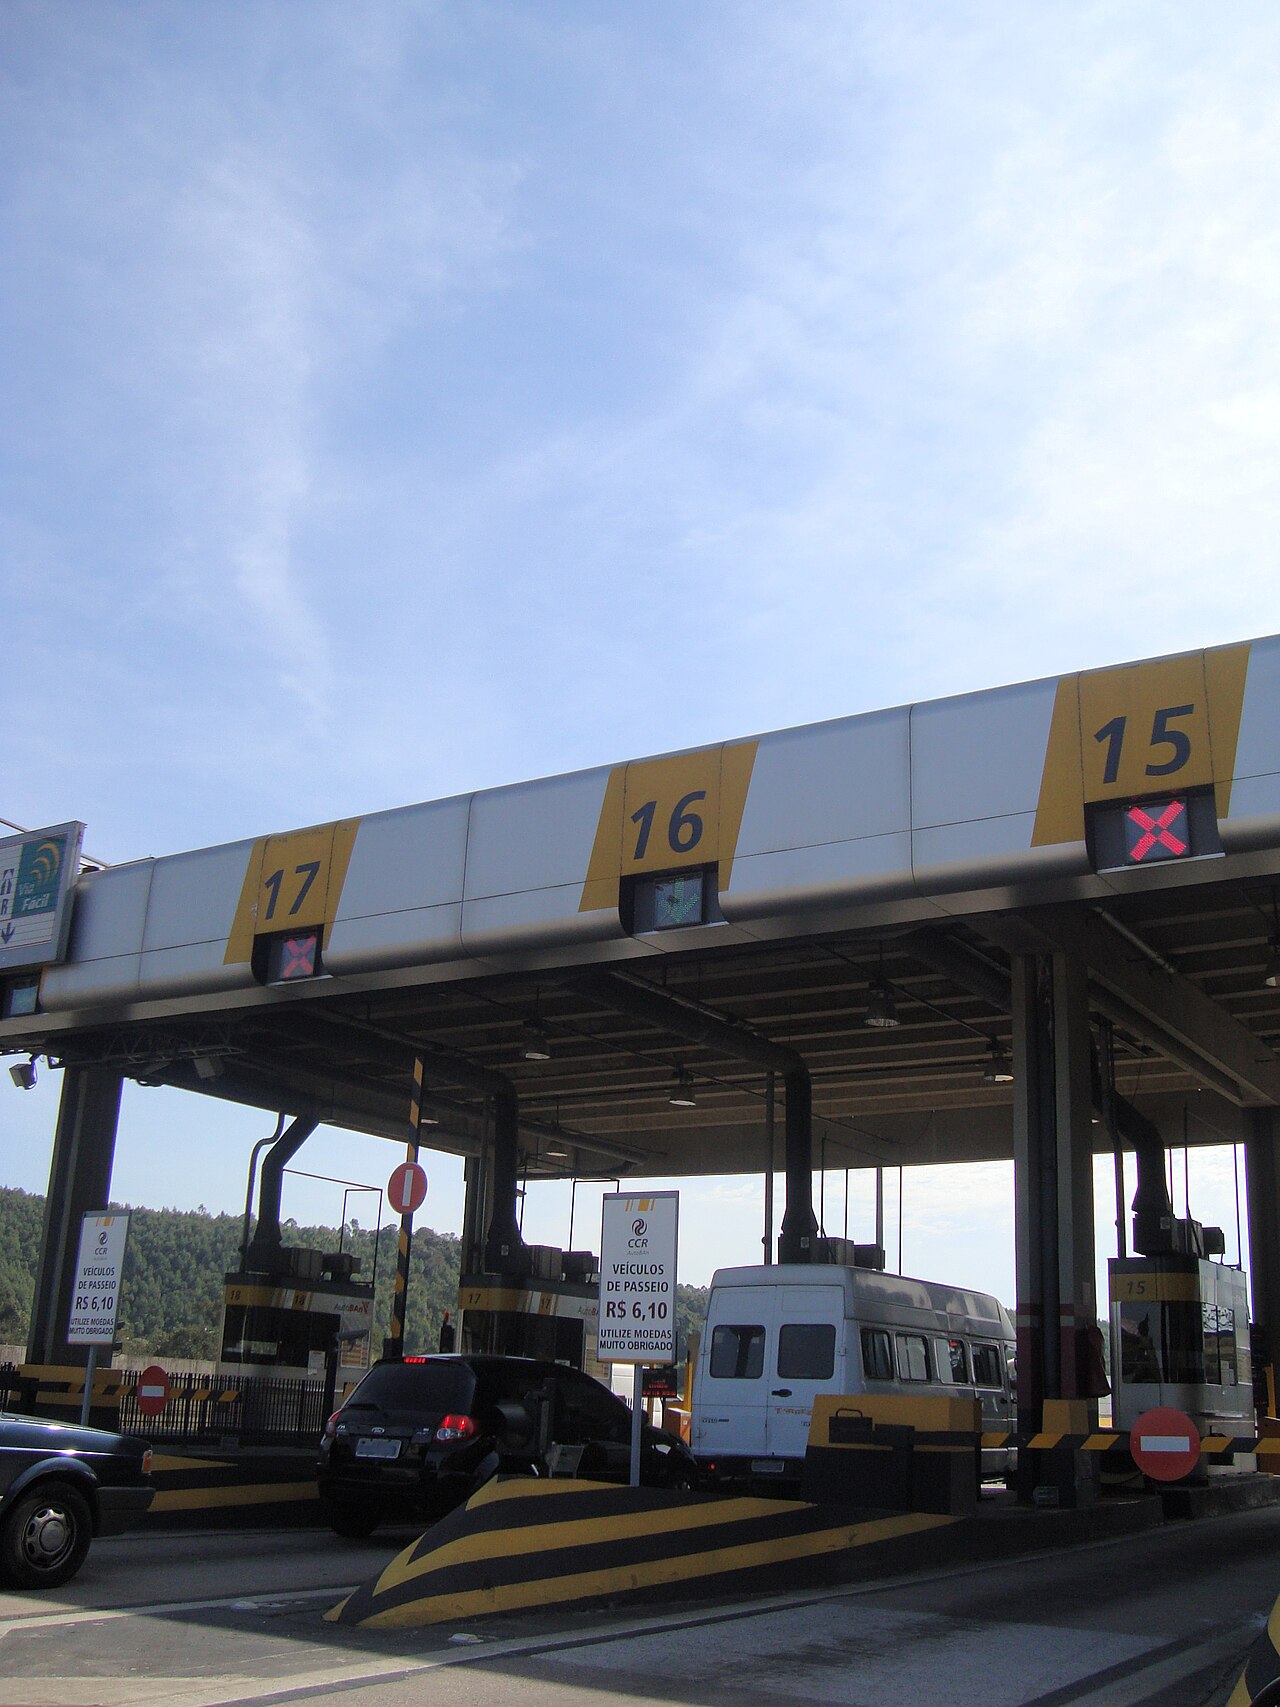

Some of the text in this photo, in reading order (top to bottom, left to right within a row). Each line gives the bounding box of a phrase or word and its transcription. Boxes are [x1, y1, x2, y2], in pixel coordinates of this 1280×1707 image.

[1093, 703, 1195, 785] 15
[630, 790, 707, 860] 16
[264, 860, 321, 921] 17
[627, 1238, 649, 1248] CCR
[83, 1265, 115, 1276] VEÍCULOS
[612, 1261, 664, 1275] VEÍCULOS
[78, 1280, 117, 1290] DE PASSEIO
[607, 1281, 669, 1293] DE PASSEIO
[1127, 1280, 1146, 1295] 15
[230, 1290, 241, 1301] 18
[468, 1293, 482, 1305] 17
[91, 1296, 114, 1312] 6,10
[606, 1300, 668, 1321] R$ 6,10
[70, 1318, 114, 1326] UTILIZE MOEDAS
[69, 1327, 114, 1335] MUITO OBRIGADO
[600, 1329, 672, 1339] UTILIZE MOEDAS
[600, 1340, 673, 1351] MUITO OBRIGADO
